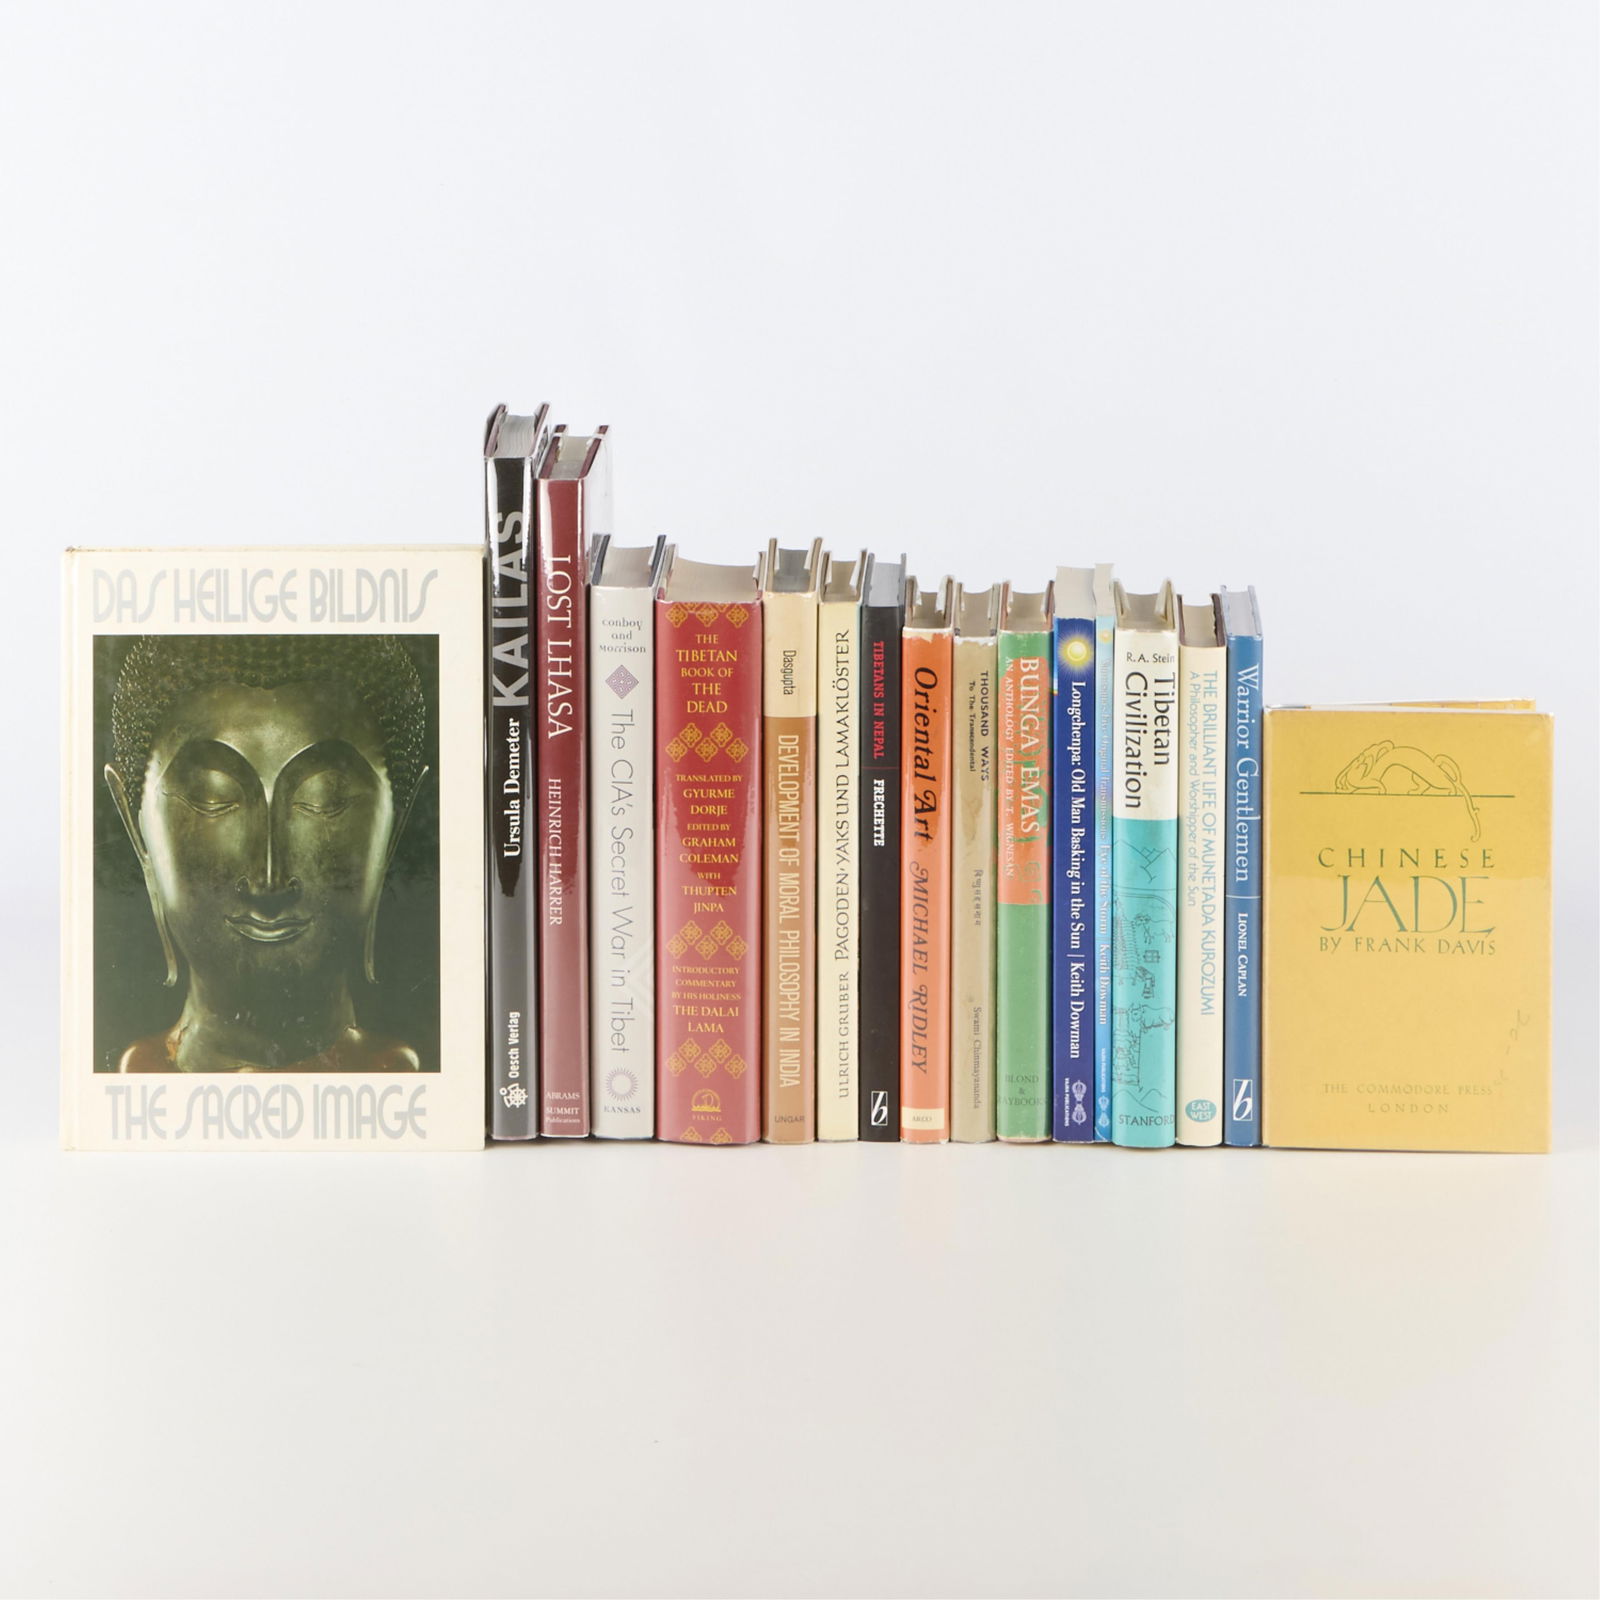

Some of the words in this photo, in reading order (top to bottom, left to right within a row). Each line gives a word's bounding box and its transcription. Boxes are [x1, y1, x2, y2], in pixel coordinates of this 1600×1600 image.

[93, 568, 166, 623] DAS
[173, 568, 298, 623] HEILIGE
[310, 568, 438, 623] BILDNIS
[546, 554, 572, 628] LOST
[492, 510, 529, 708] KAILAS
[611, 630, 632, 640] and
[696, 634, 718, 644] THE
[676, 650, 738, 662] TIBETAN
[873, 641, 884, 698] TIBETANS
[1005, 656, 1014, 672] AN
[1126, 652, 1136, 662] R.
[1138, 653, 1150, 663] A.
[1153, 653, 1175, 663] Stein
[681, 668, 714, 678] BOOK
[718, 668, 734, 678] OF
[781, 650, 797, 695] Dasgupta
[969, 681, 976, 692] To
[1190, 671, 1199, 680] A
[1203, 671, 1218, 698] THE
[547, 639, 573, 739] LHASA
[692, 683, 721, 695] THE
[832, 629, 850, 768] LAMAKLÖSTER
[980, 670, 989, 737] THOUSAND
[1020, 658, 1040, 750] BUNGA
[687, 701, 728, 713] DEAD
[873, 702, 884, 716] IN
[1005, 677, 1014, 742] ANTHOLOGY
[1154, 671, 1176, 766] Tibetan
[1188, 684, 1200, 749] Philosopher
[1236, 663, 1259, 749] Warrior
[611, 709, 635, 749] The
[914, 667, 938, 782] Oriental
[1067, 681, 1086, 765] Longchenpa:
[873, 720, 884, 760] NEPAL
[1125, 671, 1148, 809] Civilization
[1203, 703, 1217, 775] BRILLIANT
[503, 718, 521, 795] Demeter
[980, 746, 989, 782] WAYS
[1005, 748, 1014, 784] EDITED
[1190, 753, 1199, 776] and
[611, 760, 633, 816] CIA's
[676, 774, 731, 782] TRANSLATED
[732, 774, 743, 782] BY
[778, 735, 800, 843] DEVELOPMENT
[1071, 768, 1086, 792] Old
[683, 789, 735, 799] GYURME
[836, 774, 850, 816] UND
[1005, 788, 1014, 801] BY
[1020, 766, 1040, 833] EMAS
[1202, 780, 1217, 808] LIFE
[548, 778, 562, 858] HEINRICH
[690, 805, 728, 816] DORJE
[874, 779, 885, 846] FRECHETTE
[914, 789, 938, 842] Art
[1071, 797, 1086, 824] Man
[1187, 780, 1199, 842] Worshipper
[1202, 815, 1216, 836] OF
[1235, 757, 1260, 882] Gentlemen
[503, 799, 521, 858] Ursula
[682, 837, 736, 847] GRAHAM
[687, 823, 719, 831] EDITED
[720, 823, 731, 831] BY
[779, 848, 800, 867] OF
[836, 820, 850, 866] YAKS
[1066, 828, 1085, 879] Basking
[1189, 846, 1199, 860] of
[1318, 847, 1496, 869] CHINESE
[611, 826, 633, 897] Secret
[679, 854, 739, 864] COLEMAN
[1189, 865, 1199, 882] the
[681, 886, 737, 896] THUPTEN
[697, 872, 721, 880] WITH
[1071, 881, 1085, 894] in
[1201, 841, 1216, 927] MUNETADA
[549, 863, 563, 925] HARRER
[694, 902, 724, 914] JINPA
[779, 873, 800, 924] MORAL
[1071, 898, 1085, 920] the
[1189, 885, 1199, 907] Sun
[1320, 875, 1496, 934] JADE
[611, 906, 633, 959] War
[909, 861, 929, 976] MICHAEL
[1238, 913, 1248, 952] LIONEL
[1071, 922, 1085, 949] Sun
[1320, 936, 1342, 955] BY
[1354, 936, 1426, 954] FRANK
[1438, 938, 1496, 955] DAVIS
[672, 966, 740, 975] INTRODUCTORY
[1100, 944, 1110, 973] Keith
[1201, 930, 1216, 1016] KUROZUMI
[611, 969, 631, 987] in
[675, 979, 736, 988] COMMENTARY
[779, 931, 800, 1022] PHILOSOPHY
[1070, 962, 1085, 998] Keith
[1238, 954, 1248, 997] CAPLAN
[671, 992, 683, 1000] BY
[683, 992, 698, 1000] HIS
[699, 992, 741, 1001] HOLINESS
[673, 1005, 699, 1016] THE
[701, 1005, 739, 1017] DALAI
[838, 971, 849, 1038] GRUBER
[1100, 976, 1110, 1025] Dowman
[508, 1011, 520, 1045] Verlag
[611, 998, 635, 1054] Tibet
[688, 1022, 724, 1033] LAMA
[779, 1027, 800, 1042] IN
[907, 984, 928, 1074] RIDLEY
[972, 1007, 982, 1036] Swami
[1070, 1002, 1084, 1059] Dowman
[508, 1048, 520, 1079] Oesch
[779, 1050, 801, 1088] INDIA
[838, 1041, 849, 1099] ULRICH
[546, 1091, 580, 1100] ABRAMS
[1324, 1083, 1348, 1094] THE
[1356, 1083, 1450, 1095] COMMODORE
[1458, 1084, 1493, 1095] PRESS
[104, 1084, 166, 1140] THE
[175, 1084, 304, 1140] SACRED
[313, 1084, 428, 1140] IMAGE
[545, 1107, 580, 1115] SUMMIT
[604, 1106, 641, 1114] KANSAS
[692, 1114, 722, 1122] VIKING
[774, 1115, 806, 1124] UNGAR
[1118, 1114, 1175, 1126] STANFORD
[1191, 1102, 1210, 1110] EAST
[1191, 1111, 1211, 1120] WEST
[1368, 1103, 1449, 1114] LONDON
